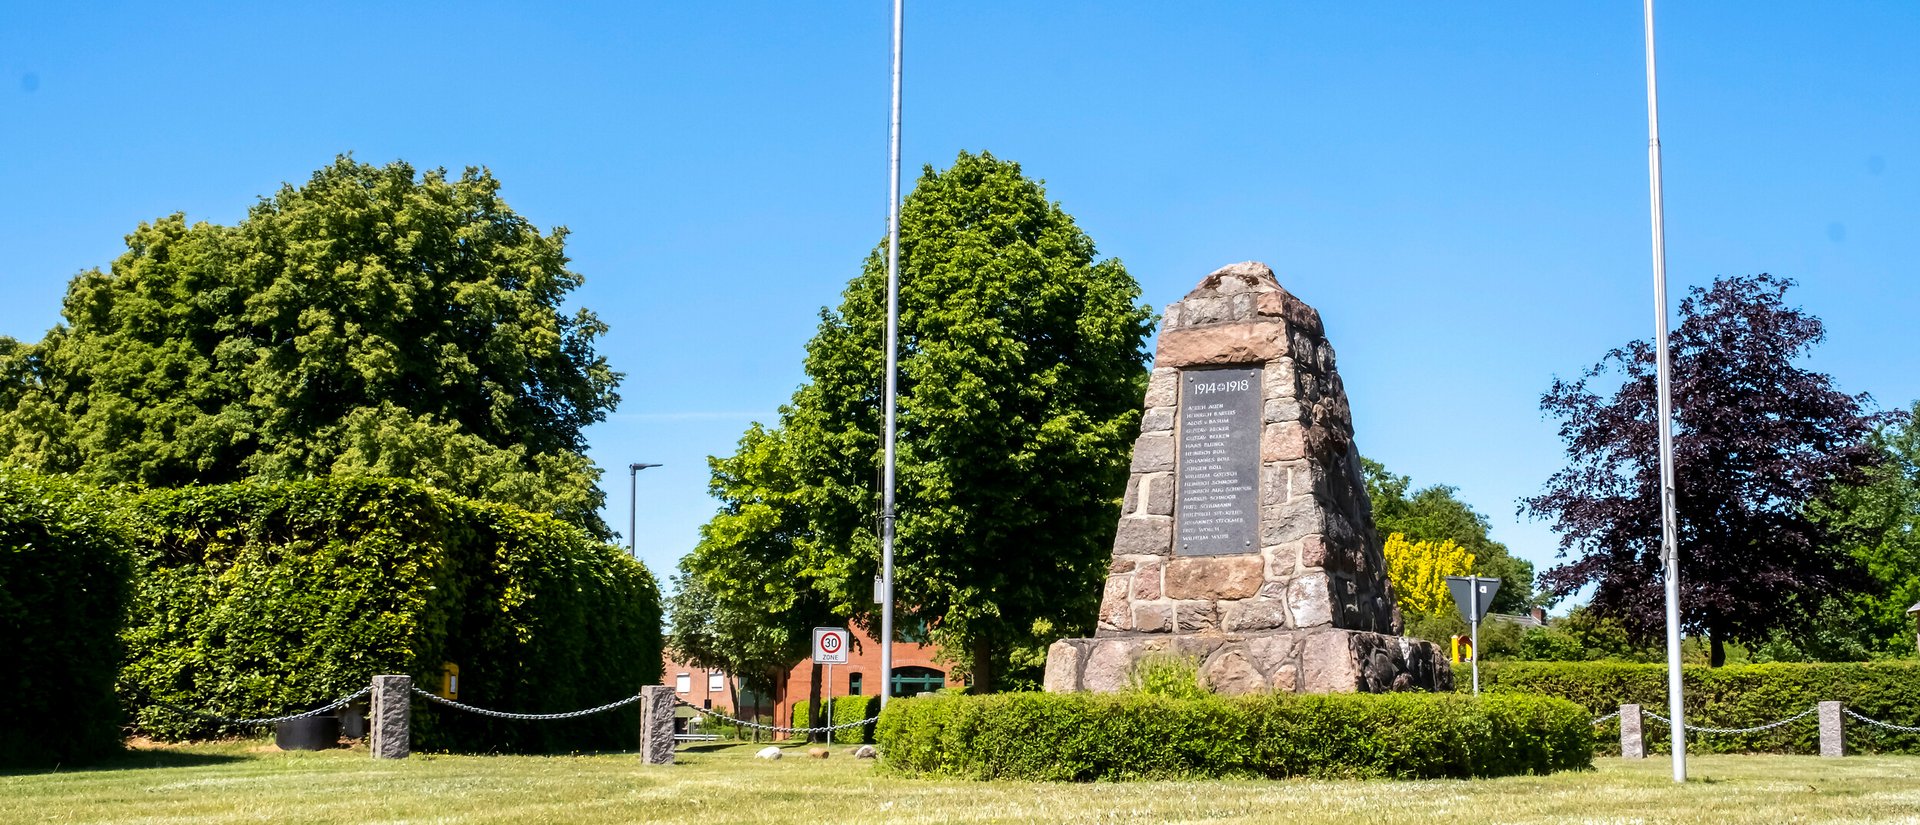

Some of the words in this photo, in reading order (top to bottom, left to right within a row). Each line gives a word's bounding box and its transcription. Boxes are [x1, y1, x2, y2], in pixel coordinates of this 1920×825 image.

[1194, 382, 1216, 394] 1914
[1226, 380, 1248, 392] 1918
[825, 638, 837, 648] 30
